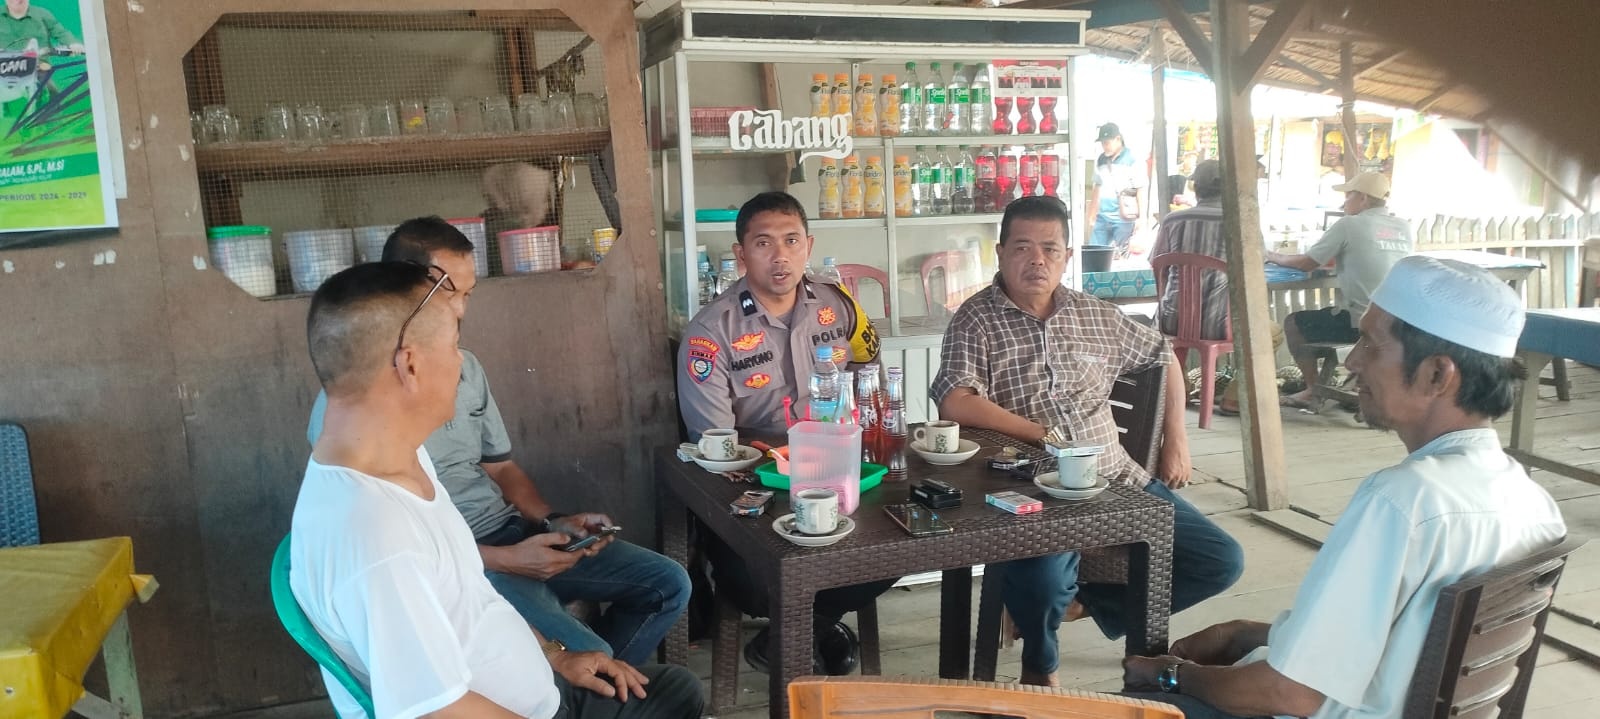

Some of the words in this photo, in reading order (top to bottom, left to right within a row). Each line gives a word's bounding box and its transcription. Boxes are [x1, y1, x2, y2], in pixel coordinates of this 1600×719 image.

[728, 109, 853, 164] Cabang
[0, 193, 36, 201] PERIODE
[811, 326, 847, 346] POLRI
[730, 351, 774, 372] HARYONO
